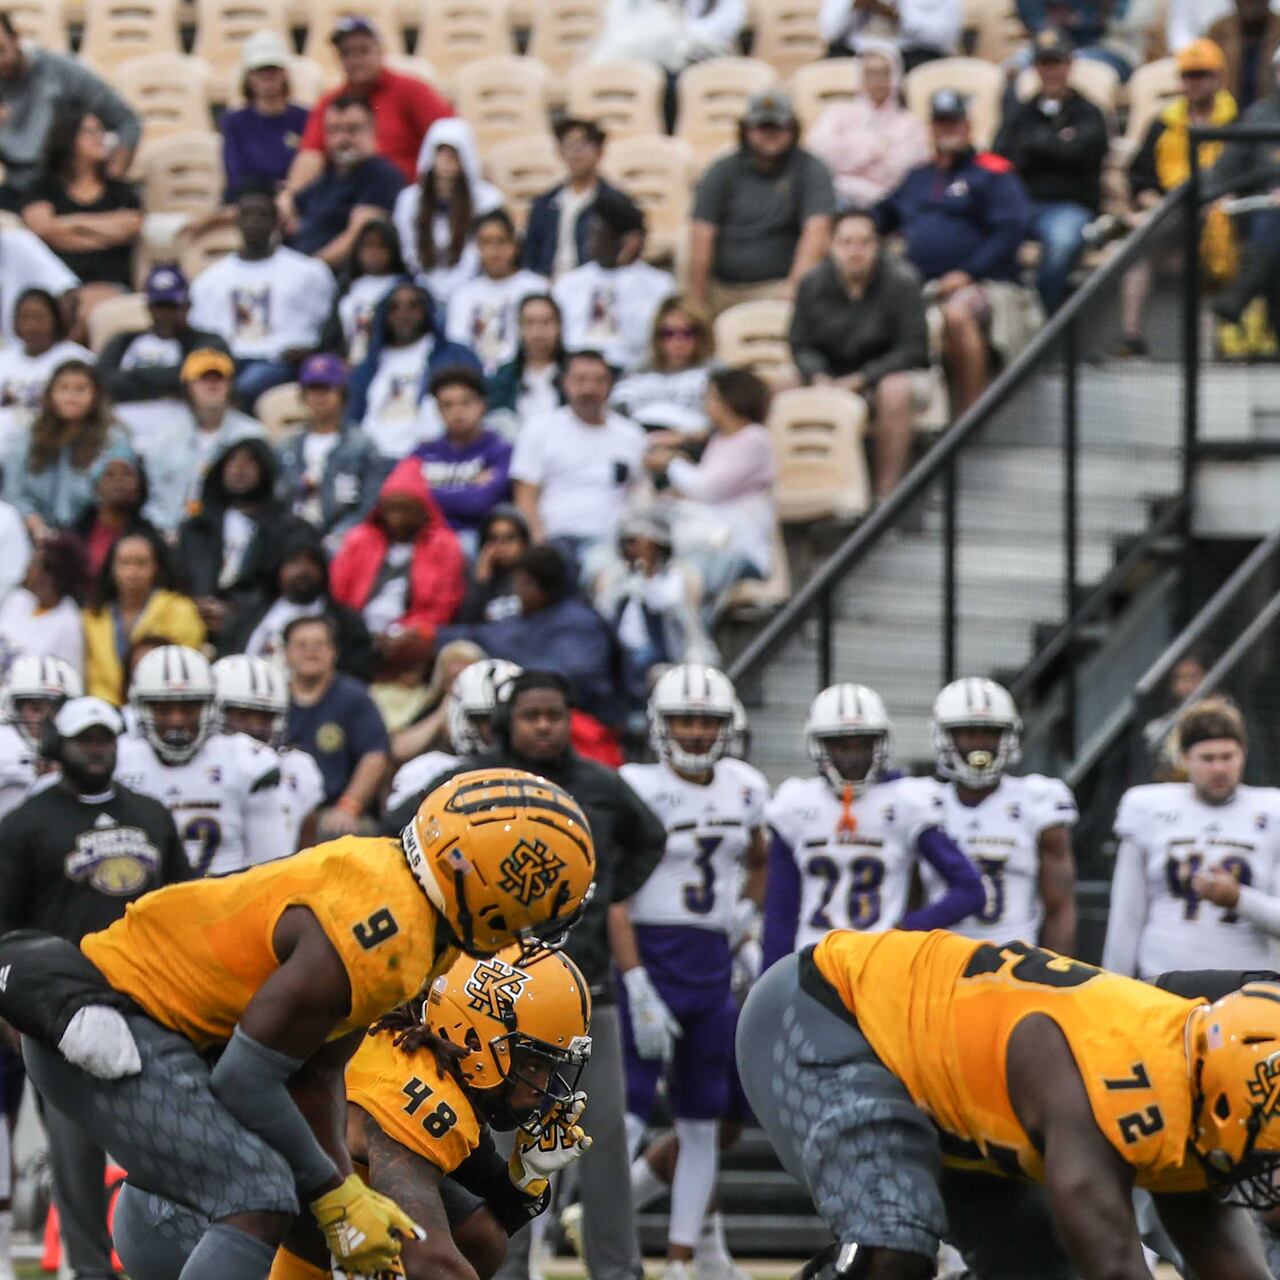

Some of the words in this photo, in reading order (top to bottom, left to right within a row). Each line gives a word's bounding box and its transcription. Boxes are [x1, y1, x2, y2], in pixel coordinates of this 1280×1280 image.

[683, 835, 724, 914] 3
[807, 856, 885, 928] 28
[352, 907, 399, 950] 9
[402, 1077, 458, 1138] 48
[1103, 1062, 1165, 1144] 72
